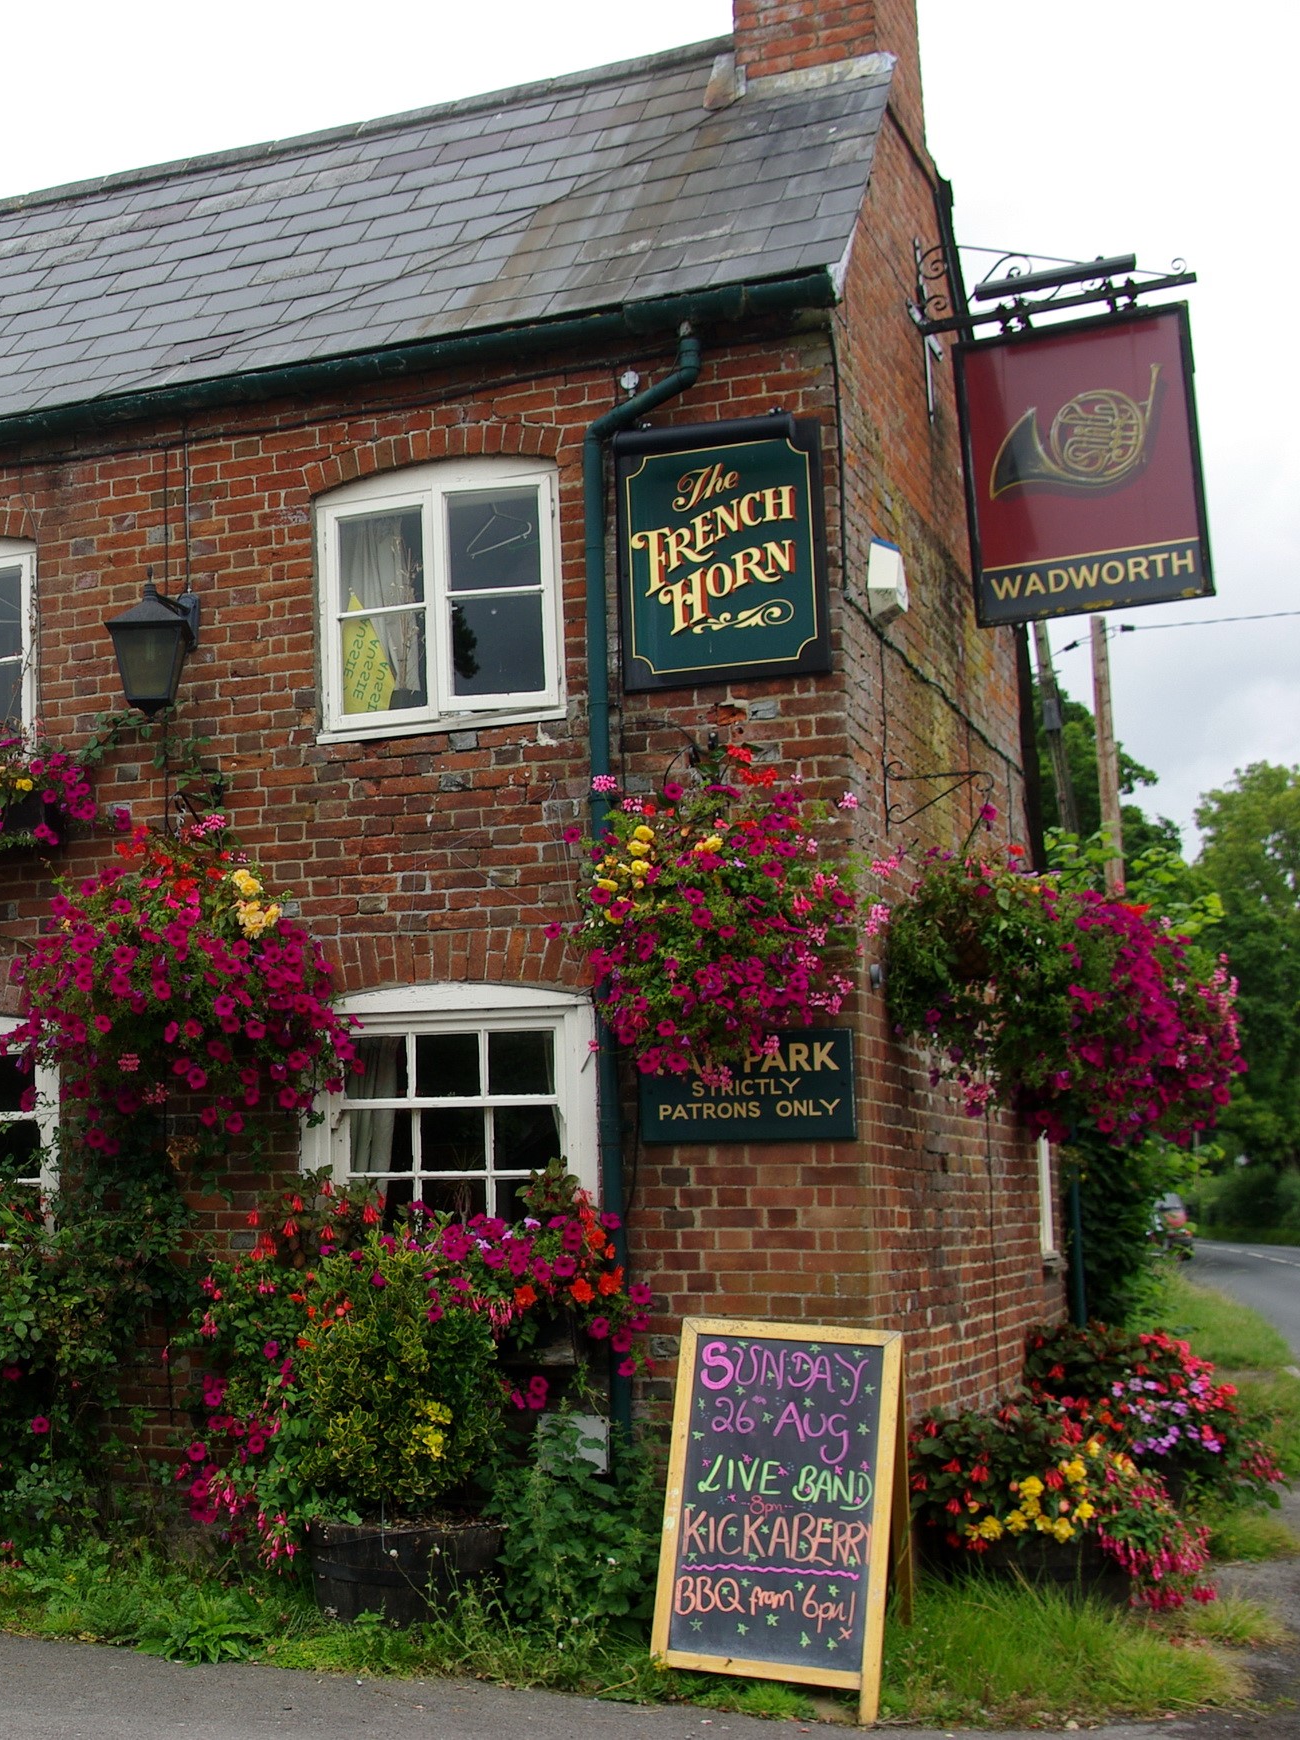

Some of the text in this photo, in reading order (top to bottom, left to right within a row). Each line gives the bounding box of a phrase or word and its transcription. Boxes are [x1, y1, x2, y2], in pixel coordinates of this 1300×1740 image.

[672, 462, 740, 512] The
[631, 485, 796, 597] FRENCH
[658, 539, 795, 636] HORN
[991, 549, 1196, 600] WADWORTH
[743, 1041, 840, 1073] PARK
[659, 1098, 841, 1121] PATRONS ONLY
[700, 1341, 869, 1406] SUNDAY
[698, 1454, 873, 1511] LIVE BAND
[681, 1508, 873, 1567] KICKABERRY
[674, 1575, 746, 1615] BBQ
[748, 1585, 795, 1616] from
